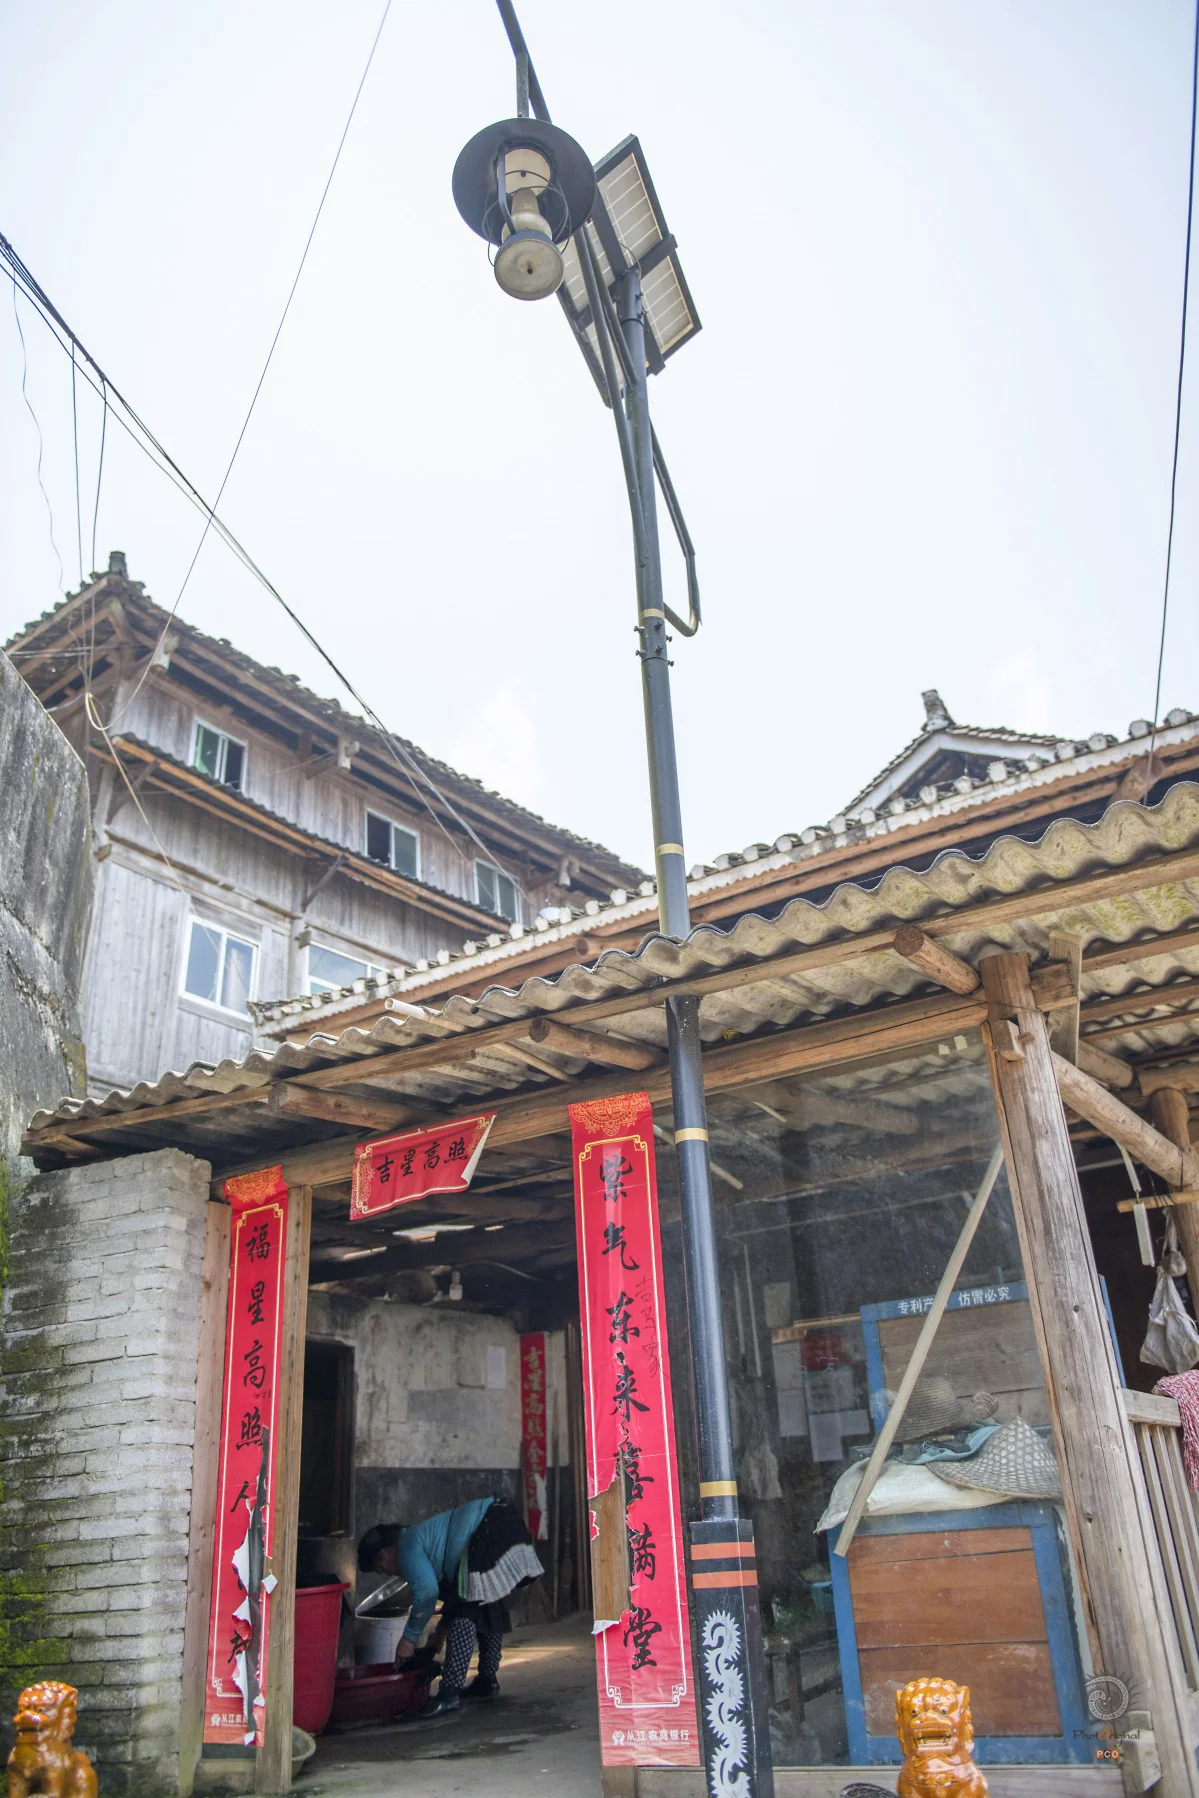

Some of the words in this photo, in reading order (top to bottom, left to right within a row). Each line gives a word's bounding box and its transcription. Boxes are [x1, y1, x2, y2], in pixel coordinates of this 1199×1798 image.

[377, 1137, 468, 1184] 吉星高照
[898, 1297, 947, 1315] 专利产
[958, 1286, 1011, 1306] 仿冒必究
[600, 1154, 662, 1670] 紫气东来喜满堂
[227, 1222, 270, 1663] 福星高照人
[626, 1729, 690, 1741] 从江农商银行
